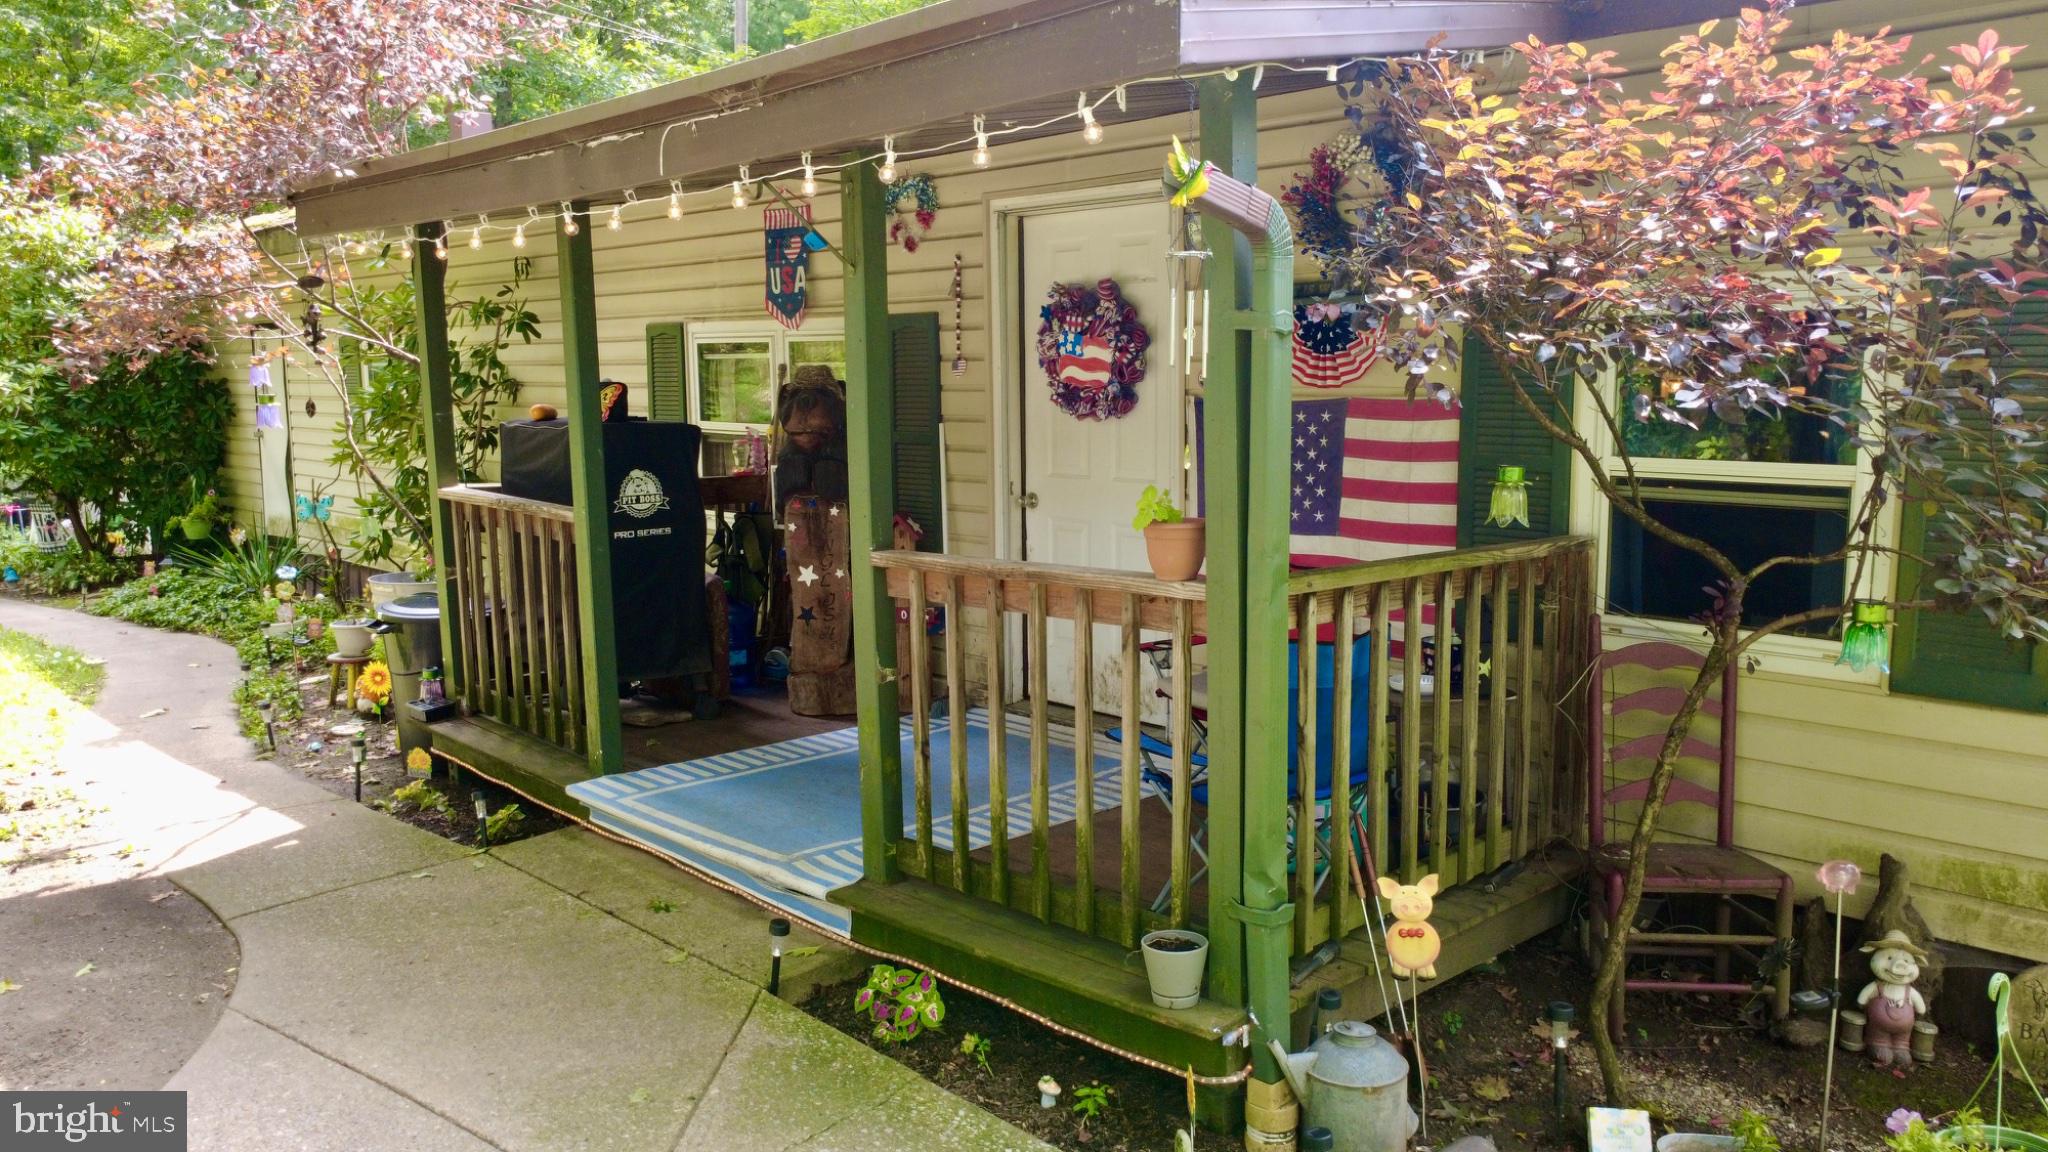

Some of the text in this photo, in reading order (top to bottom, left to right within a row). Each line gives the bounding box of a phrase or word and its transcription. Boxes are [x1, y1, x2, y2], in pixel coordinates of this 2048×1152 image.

[770, 265, 806, 295] USA
[622, 495, 661, 505] PIT BOSS
[614, 528, 672, 539] PRO SERIES
